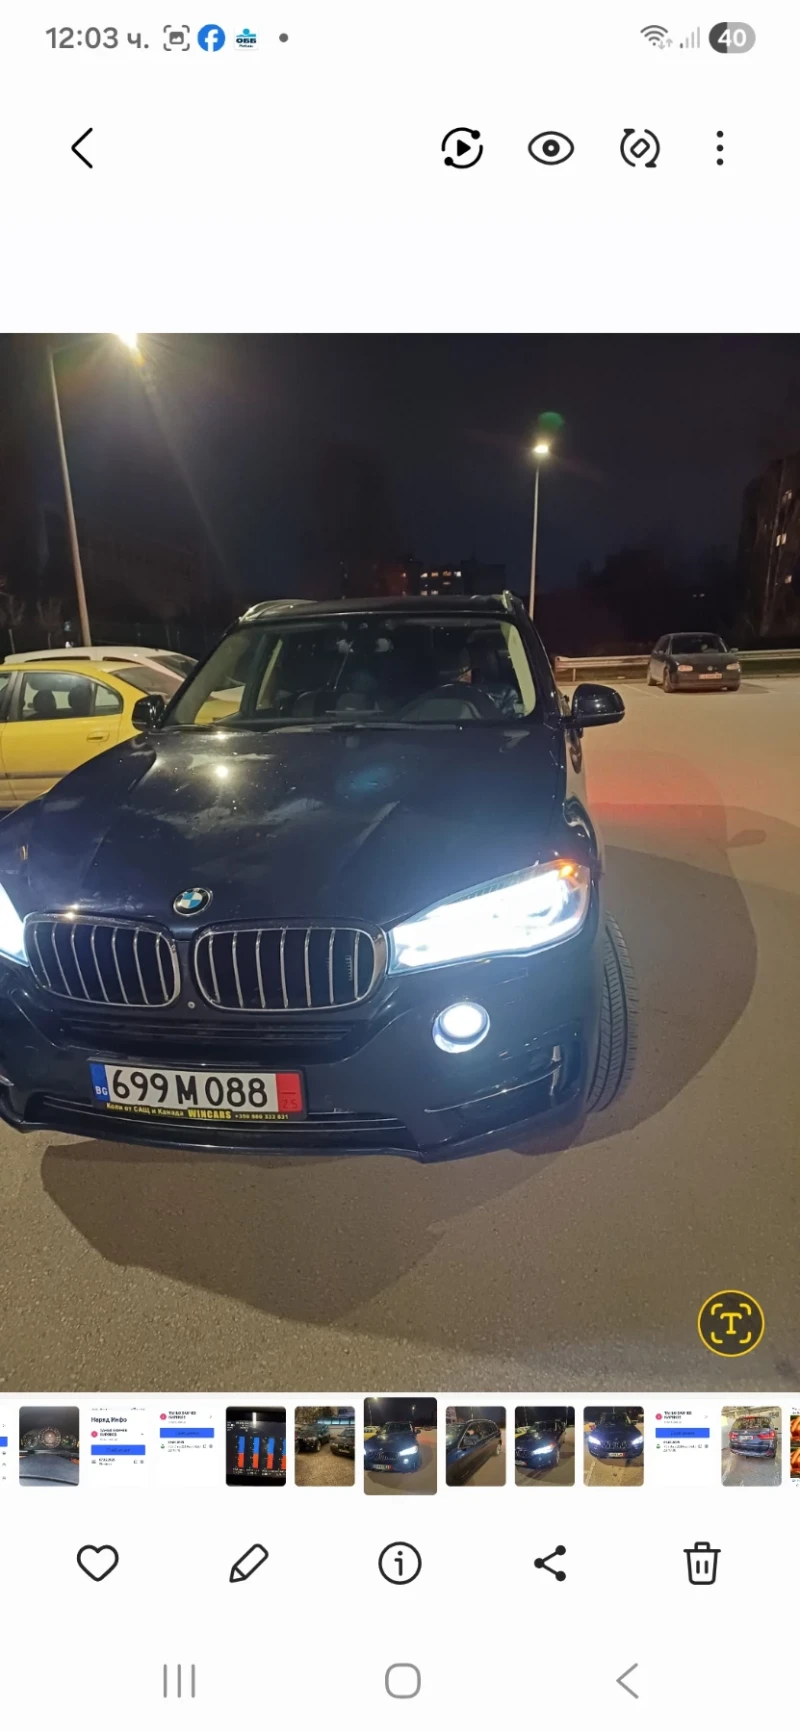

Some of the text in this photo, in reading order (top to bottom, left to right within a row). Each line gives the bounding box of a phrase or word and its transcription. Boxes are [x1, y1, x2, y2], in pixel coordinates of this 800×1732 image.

[45, 27, 119, 49] 12:03
[717, 29, 747, 47] 40
[95, 1085, 108, 1096] BG
[112, 1069, 268, 1108] 699 M 088
[282, 1098, 297, 1109] 25
[187, 1109, 232, 1119] WINCARS
